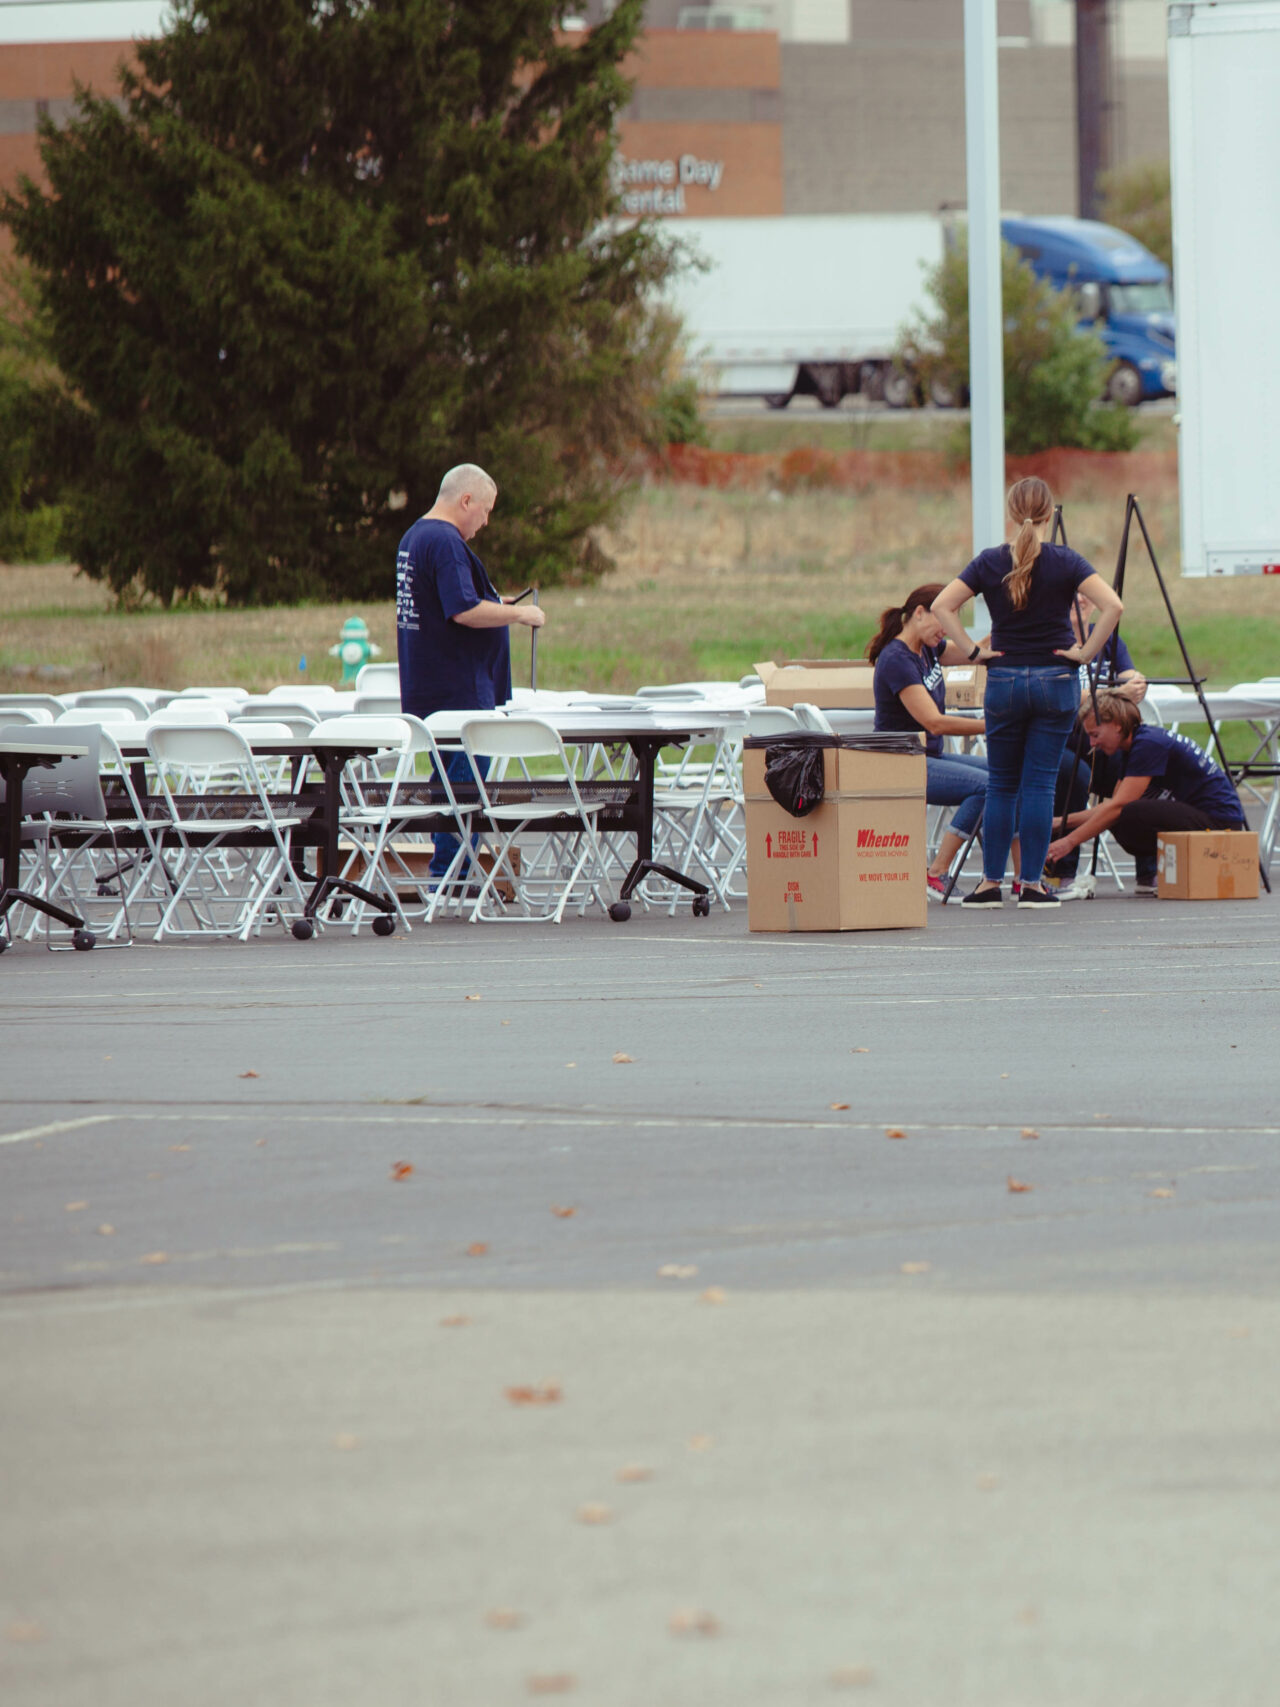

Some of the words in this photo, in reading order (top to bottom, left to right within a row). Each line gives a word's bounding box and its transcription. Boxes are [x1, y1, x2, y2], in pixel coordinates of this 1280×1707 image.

[679, 155, 724, 191] Day
[778, 830, 806, 844] FRAGILE
[857, 829, 909, 848] Wheaton
[859, 873, 867, 881] WE
[869, 873, 882, 881] MOVE
[899, 872, 909, 880] LIFE
